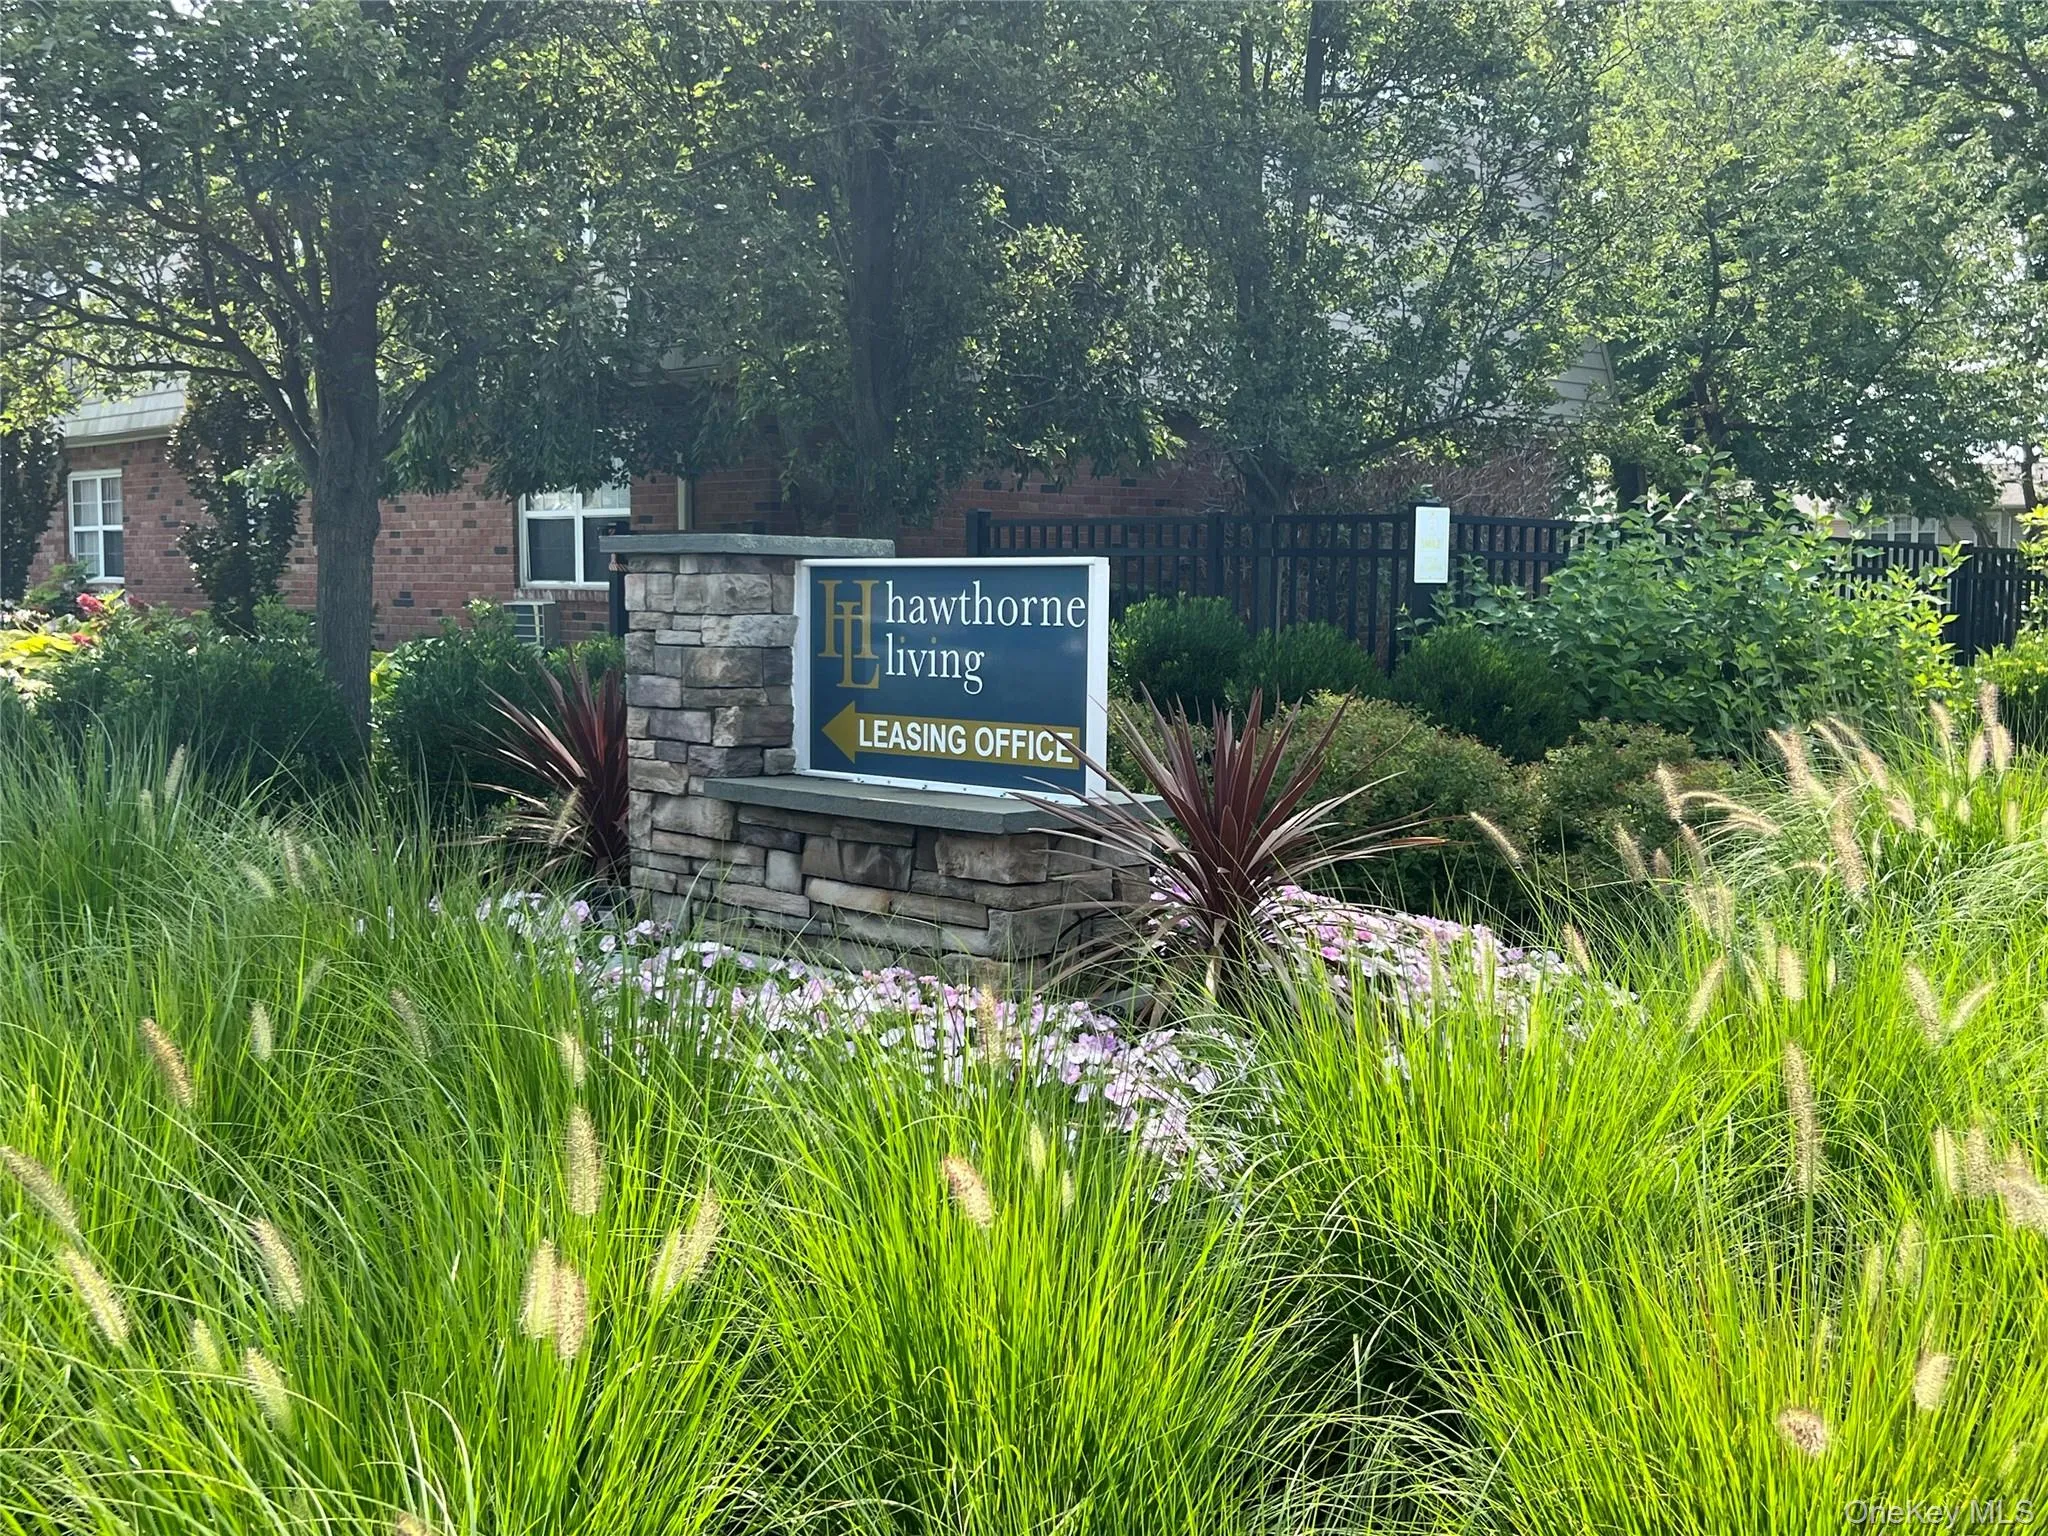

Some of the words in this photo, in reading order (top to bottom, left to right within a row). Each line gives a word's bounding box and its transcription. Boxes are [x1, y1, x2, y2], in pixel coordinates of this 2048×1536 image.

[885, 580, 1086, 627] hawthorne
[885, 633, 985, 695] living
[858, 719, 966, 754] LEASING
[974, 727, 1073, 763] OFFICE
